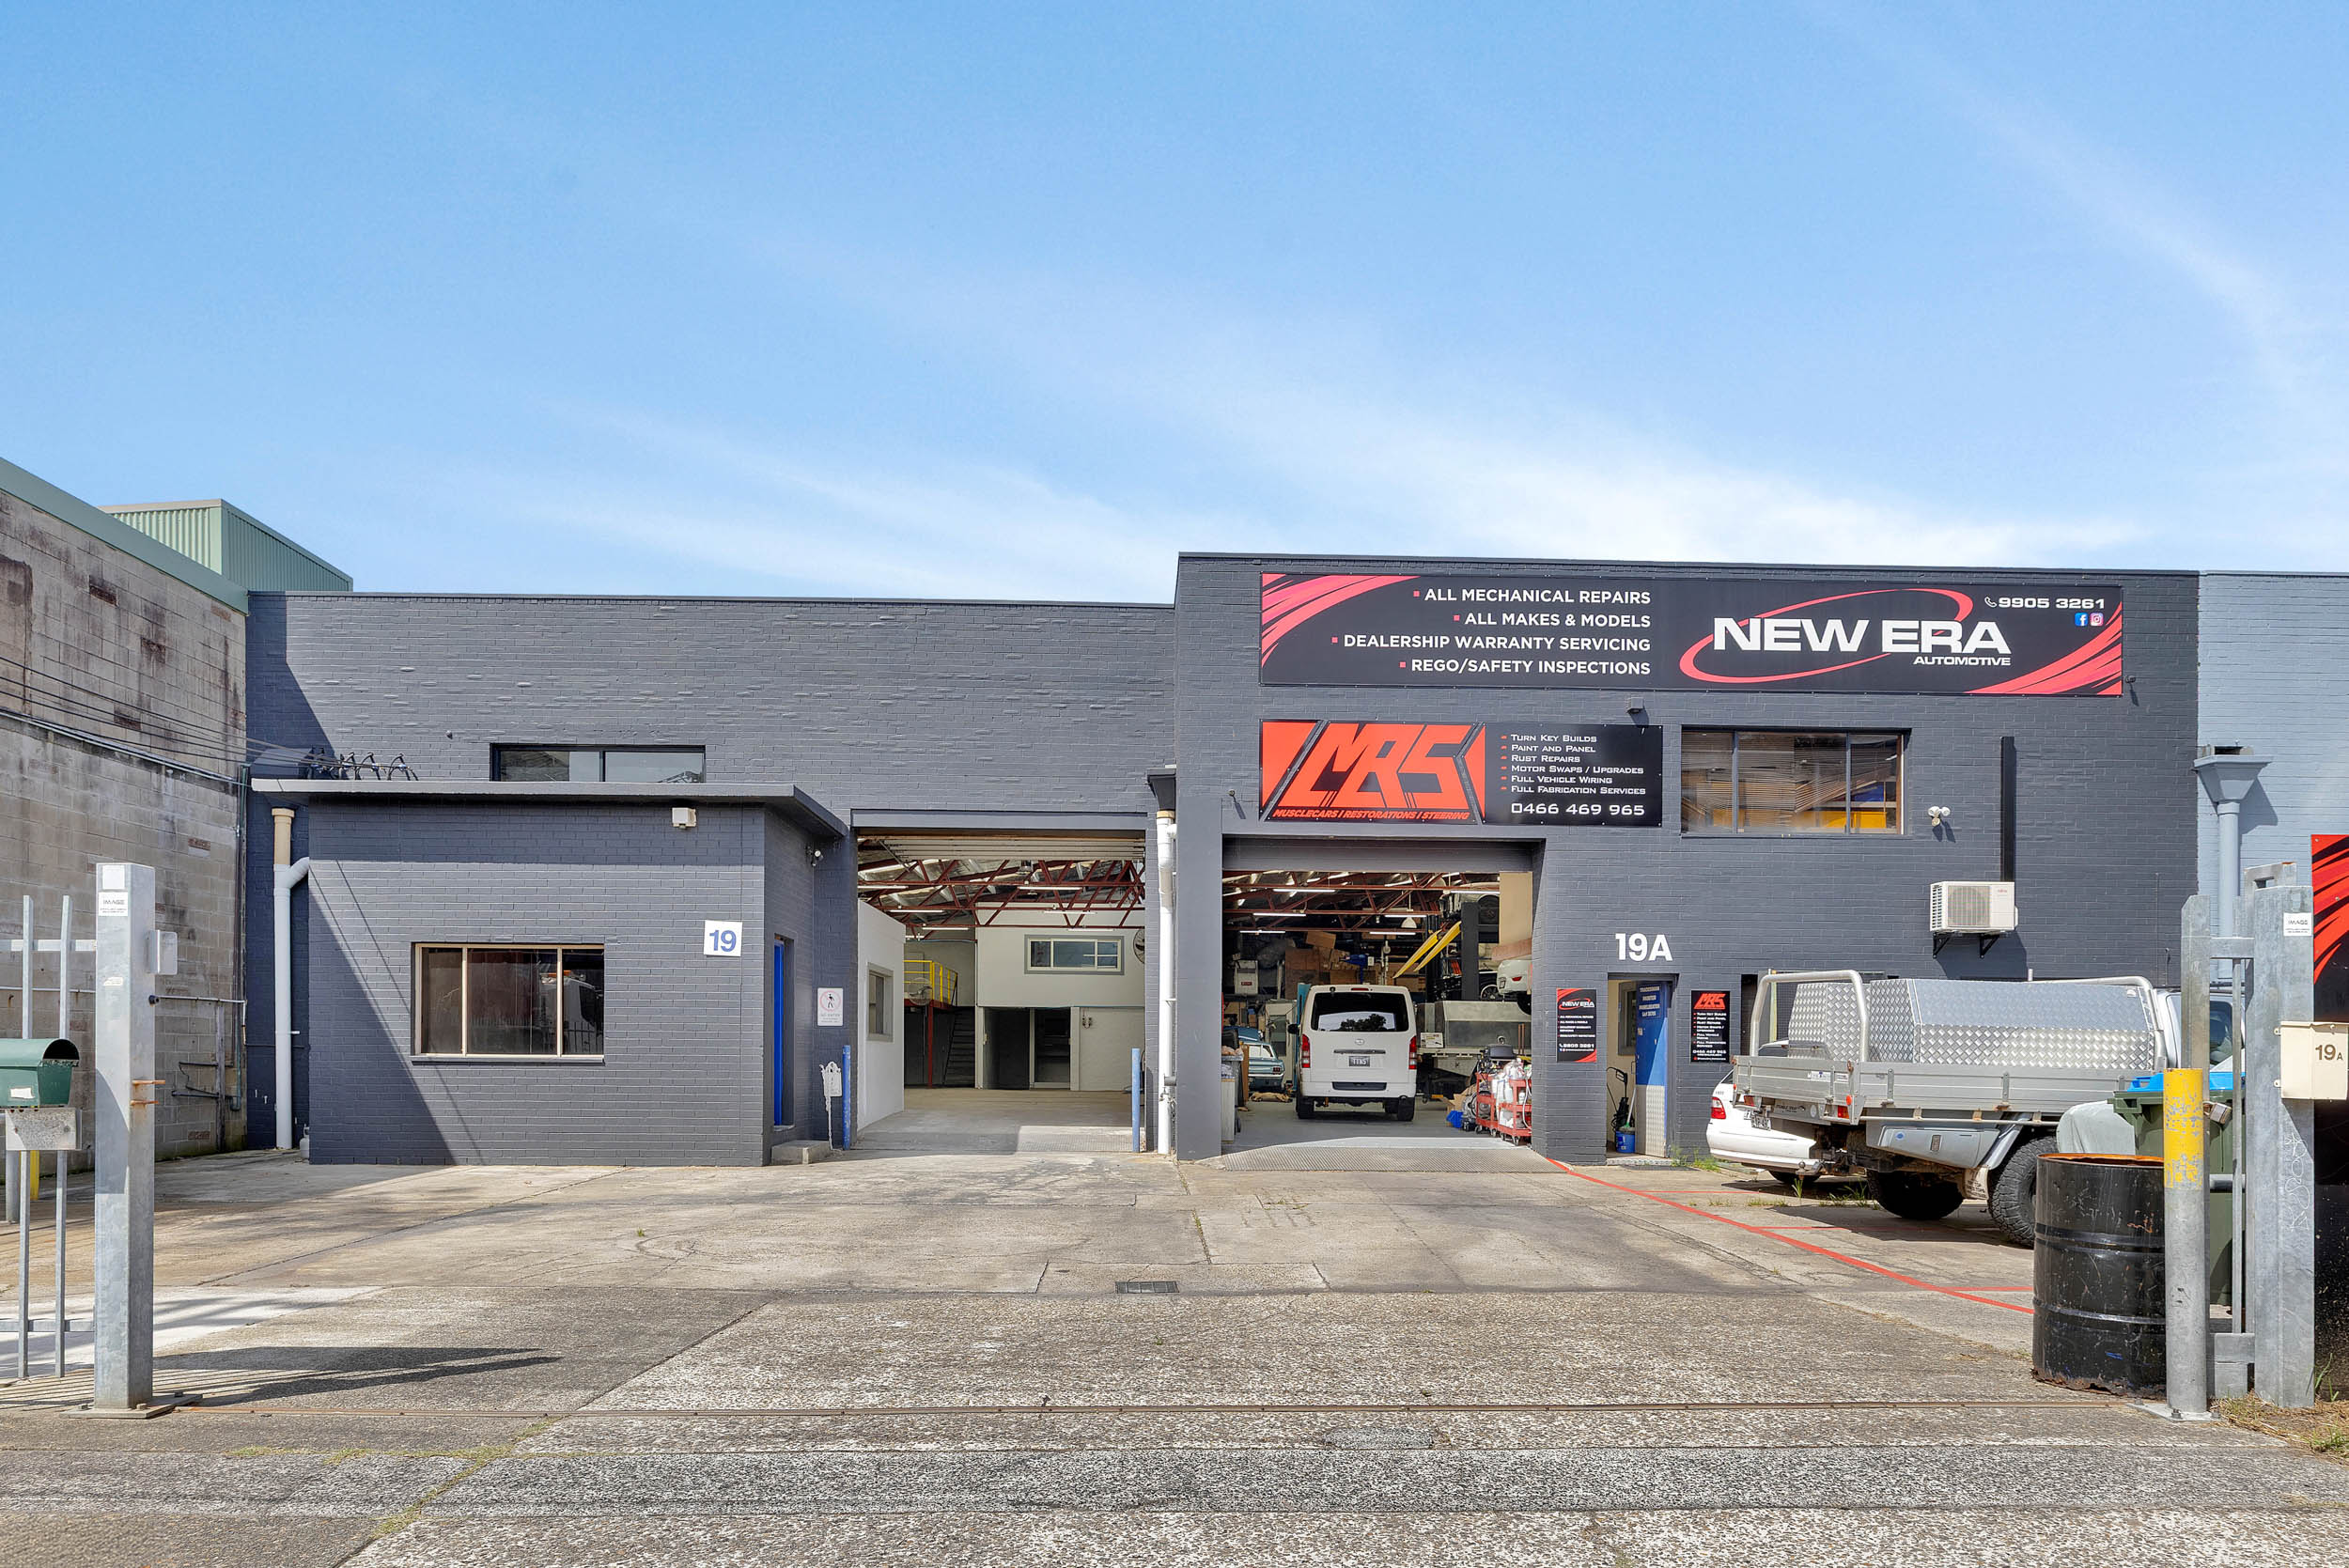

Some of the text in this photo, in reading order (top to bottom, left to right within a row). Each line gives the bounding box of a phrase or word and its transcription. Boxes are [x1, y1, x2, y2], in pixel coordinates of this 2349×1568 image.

[1424, 588, 1651, 605] ALL MECHANICAL REPAIRS
[1999, 597, 2105, 610] 9905 3261
[1465, 613, 1651, 628] ALL MAKES & MODELS
[1344, 634, 1651, 652] DEALERSHIP WARRANTY SERVICING
[1714, 617, 2012, 655] NEW ERA
[1411, 659, 1651, 675] REGO/SAFETY INSPECTIONS
[1913, 656, 2012, 666] AUTOMOTIVE
[1272, 809, 1338, 818] MUSCLECARS
[1343, 810, 1417, 819] RESTORATIONS
[1422, 812, 1470, 820] STEERING
[1511, 803, 1645, 815] 0466 469 965
[709, 929, 737, 952] 19
[1615, 933, 1673, 961] 19A
